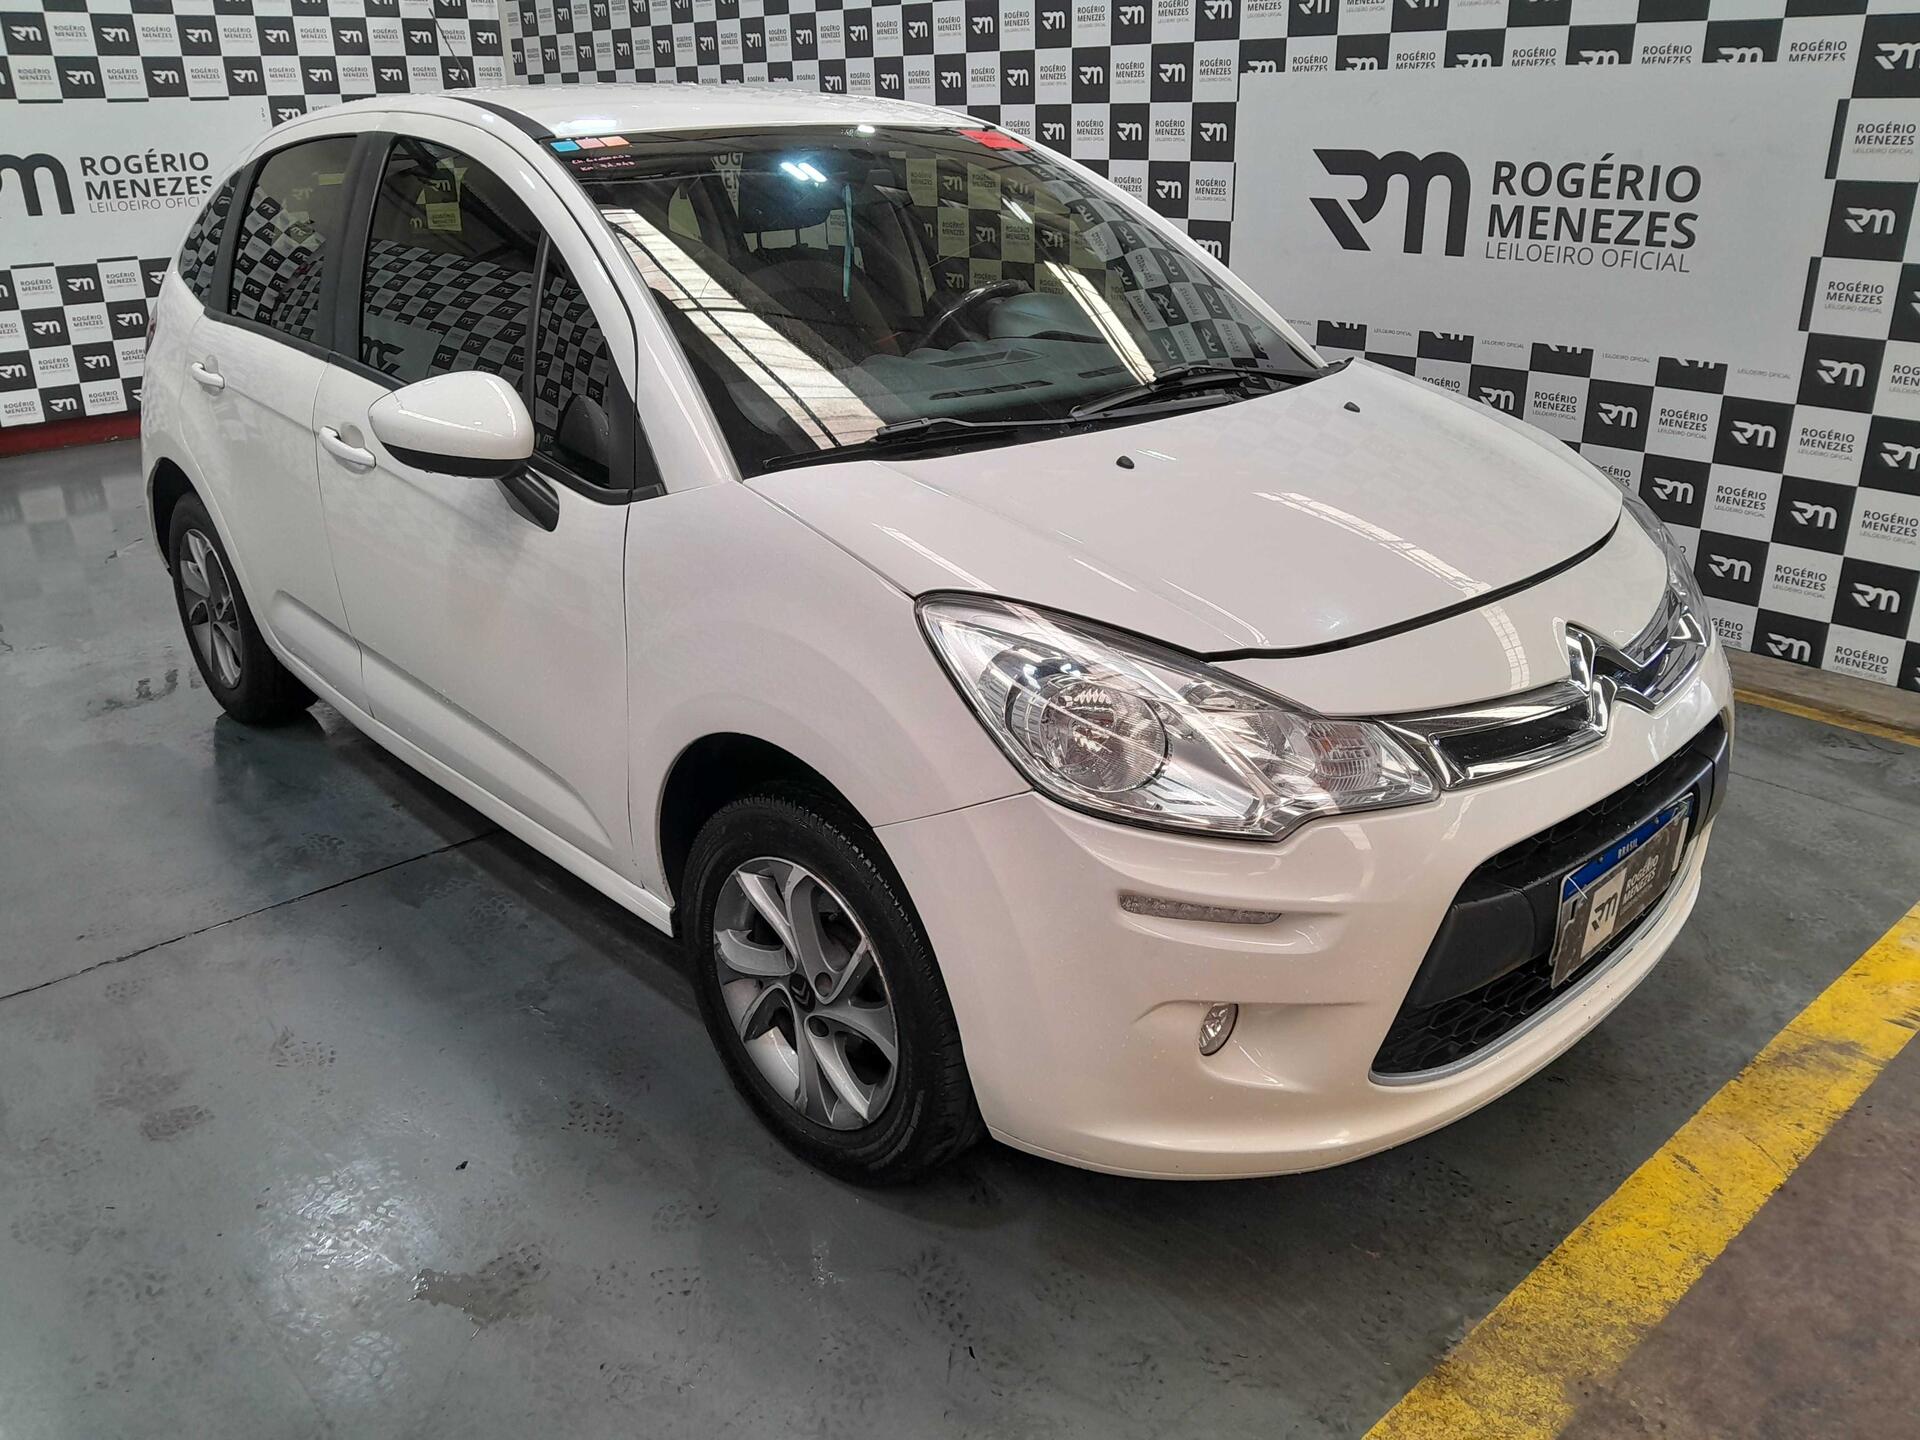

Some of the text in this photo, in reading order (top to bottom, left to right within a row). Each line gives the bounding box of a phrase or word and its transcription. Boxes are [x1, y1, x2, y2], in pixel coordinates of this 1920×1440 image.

[1077, 5, 1105, 15] ROGÉRIO
[1158, 8, 1189, 17] MENEZES
[1247, 2, 1282, 11] MENEZES
[1004, 10, 1030, 19] ROGÉRIO
[1077, 13, 1106, 22] MENEZES
[937, 23, 961, 32] MENEZES
[1004, 18, 1030, 27] MENEZES
[1643, 43, 1693, 55] ROGÉRIO
[1790, 39, 1847, 52] ROGÉRIO
[1396, 51, 1436, 62] ROGÉRIO
[1512, 46, 1557, 58] ROGÉRIO
[1200, 58, 1232, 67] ROGÉRIO
[1292, 53, 1328, 65] ROGÉRIO
[971, 66, 995, 76] ROGÉRIO
[1040, 64, 1066, 73] ROGÉRIO
[1116, 61, 1145, 71] ROGÉRIO
[1200, 66, 1232, 76] MENEZES
[971, 74, 996, 83] MENEZES
[1040, 72, 1067, 81] MENEZES
[1116, 69, 1145, 78] MENEZES
[908, 77, 931, 85] MENEZES
[1005, 119, 1030, 128] ROGÉRIO
[1076, 119, 1104, 128] ROGÉRIO
[1155, 118, 1185, 128] ROGÉRIO
[1857, 121, 1916, 134] ROGÉRIO
[1076, 127, 1104, 136] MENEZES
[1155, 126, 1185, 136] MENEZES
[1854, 135, 1915, 146] MENEZES
[80, 148, 209, 177] ROGÉRIO
[1195, 177, 1227, 187] ROGÉRIO
[1492, 153, 1701, 203] ROGÉRIO
[85, 175, 213, 201] MENEZES
[1195, 186, 1226, 196] MENEZES
[89, 196, 201, 214] LEILOEIRO OFICI
[1487, 203, 1699, 250] MENEZES
[1485, 242, 1691, 274] LEILOEIRO OFICIAL
[1828, 280, 1884, 294] ROGÉRIO
[1826, 292, 1883, 305] MENEZES
[1534, 391, 1577, 404] ROGÉRIO
[1533, 400, 1577, 413] MENEZES
[1660, 408, 1708, 422] ROGÉRIO
[1659, 417, 1707, 431] MENEZES
[1801, 427, 1855, 443] ROGÉRIO
[1800, 438, 1853, 453] MENEZES
[1601, 465, 1631, 478] GÉRIO
[1717, 485, 1767, 500] ROGÉRIO
[1715, 495, 1766, 511] MENEZES
[1863, 510, 1919, 527] ROGÉRIO
[1861, 520, 1918, 538] MENEZES
[1775, 564, 1827, 582] ROGÉRIO
[1773, 573, 1826, 592] MENEZES
[1711, 617, 1744, 631] GÉRIO
[1836, 645, 1889, 665] ROGÉRIO
[1833, 655, 1888, 675] MENEZES
[1617, 838, 1638, 859] BRASIL
